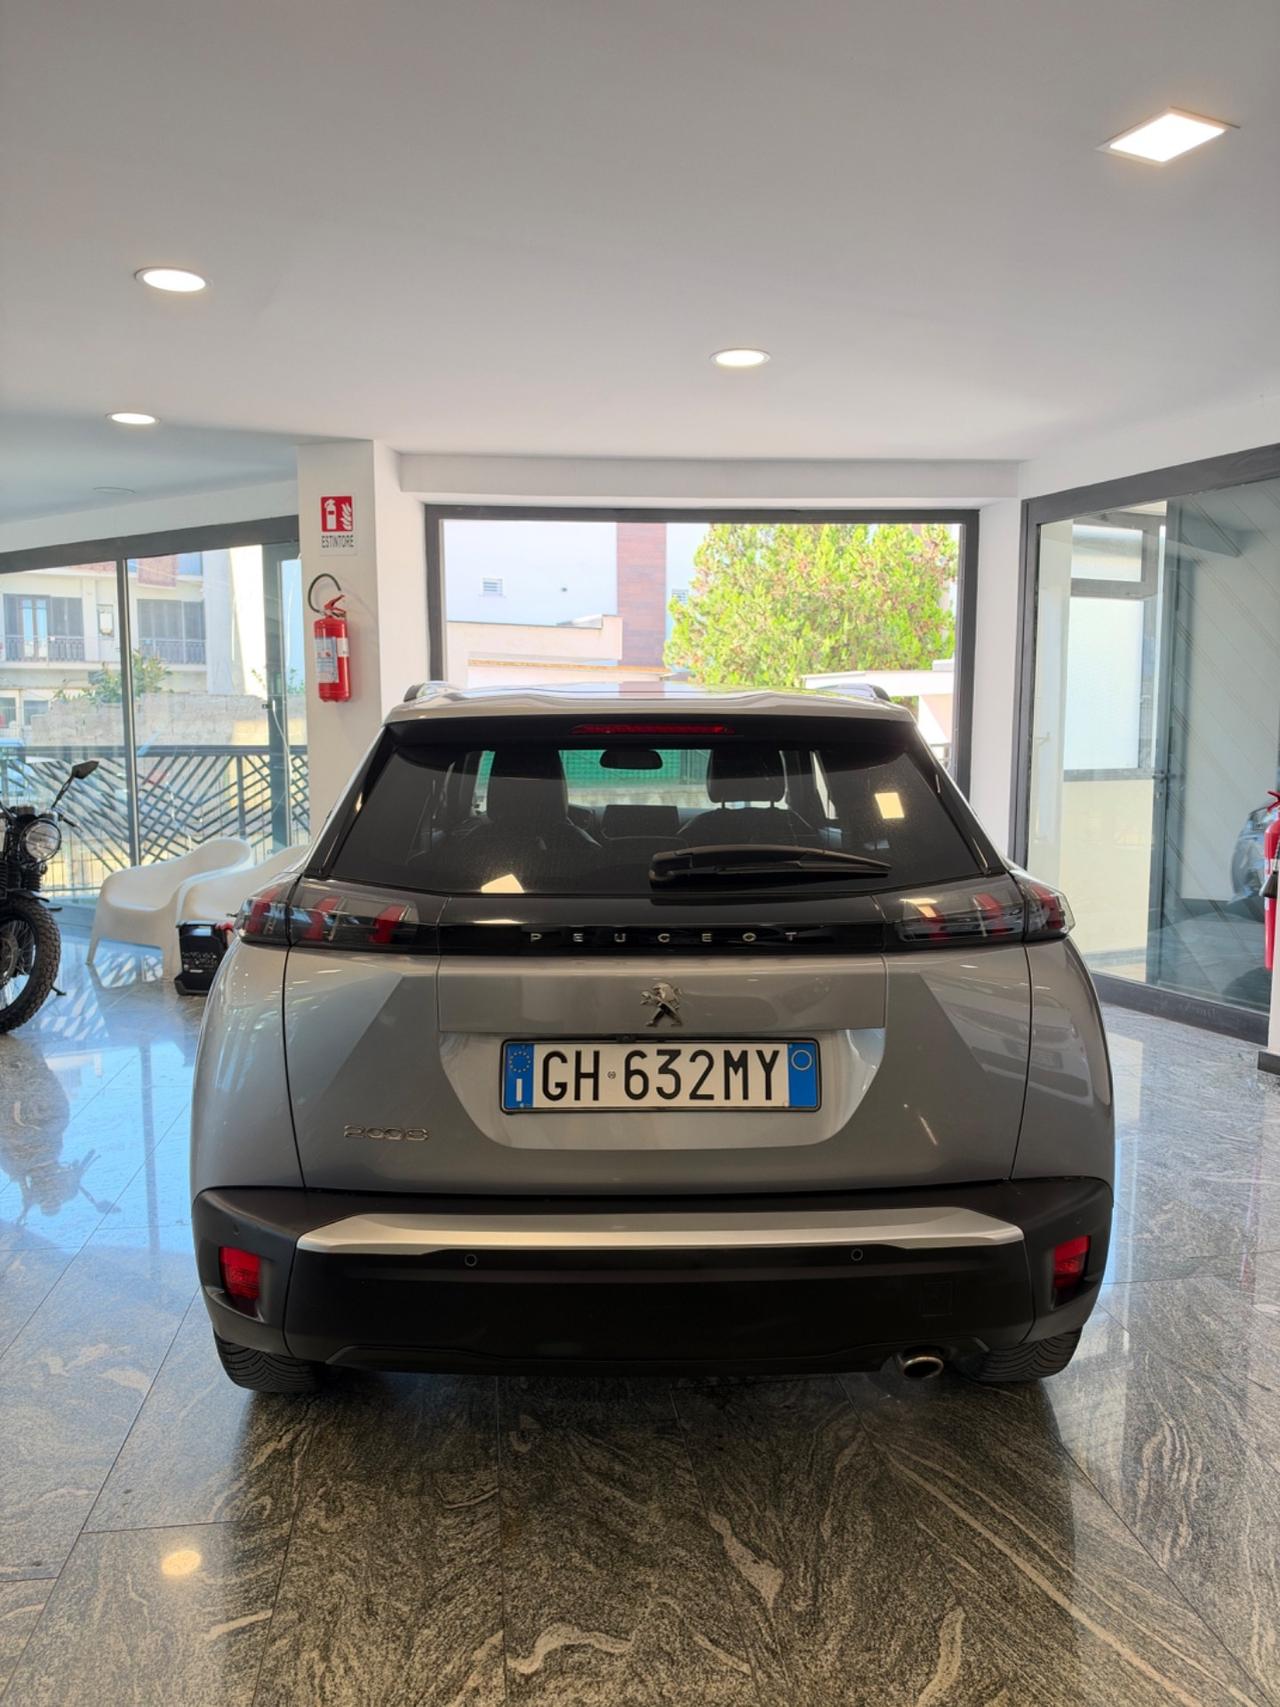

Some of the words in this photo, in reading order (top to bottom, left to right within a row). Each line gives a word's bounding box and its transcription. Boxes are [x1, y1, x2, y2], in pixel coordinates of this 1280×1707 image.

[321, 534, 354, 548] ESTINTORE
[530, 931, 798, 943] PEUGEOT
[343, 1125, 429, 1141] 2008
